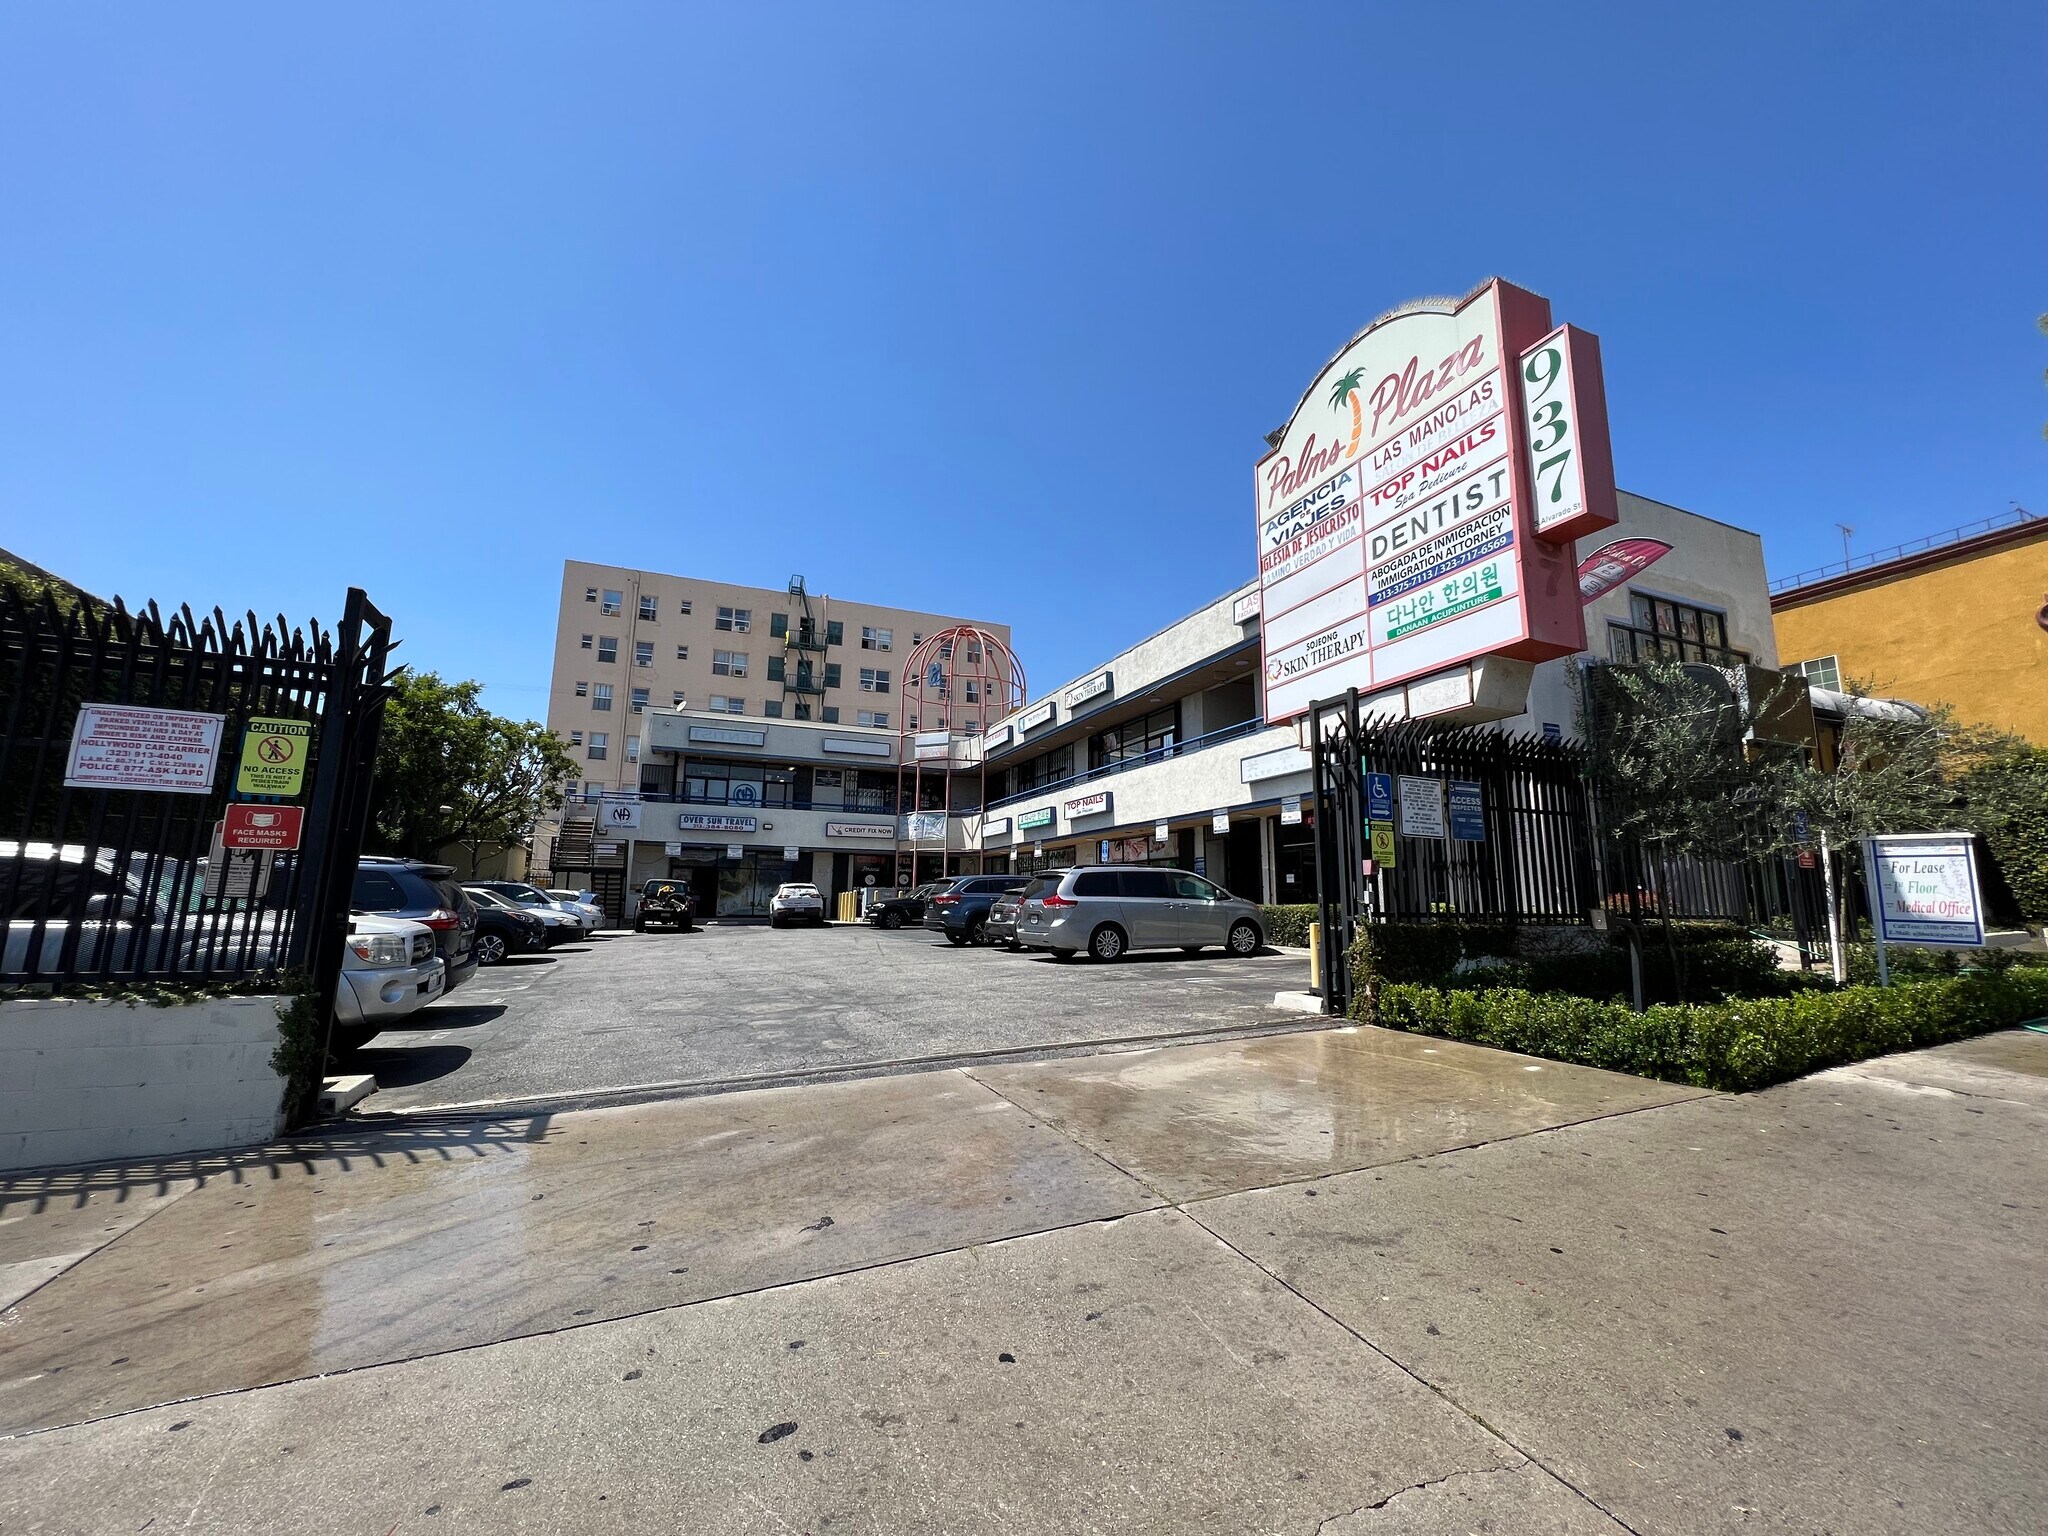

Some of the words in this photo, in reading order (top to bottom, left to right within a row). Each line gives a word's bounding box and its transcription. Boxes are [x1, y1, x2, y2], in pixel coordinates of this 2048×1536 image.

[1267, 433, 1347, 509] Palms
[1369, 334, 1484, 438] Plaza
[1374, 441, 1402, 471] LAS
[1409, 381, 1493, 448] MANOLAS
[1525, 348, 1571, 503] 937
[1375, 451, 1414, 483] SALON
[1438, 399, 1499, 444] BELLEZA
[1370, 472, 1415, 507] TOP
[1421, 421, 1496, 479] NAILS
[1394, 492, 1416, 510] Spa
[1418, 462, 1468, 495] Pedicure
[1265, 473, 1352, 536] AGENCIA
[1300, 509, 1311, 519] DE
[1371, 468, 1506, 561] DENTIST
[1272, 495, 1345, 546] VIAJES
[1261, 544, 1291, 575] IGLESIA
[1292, 537, 1303, 556] DE
[1304, 503, 1360, 549] JESUCRISTO
[1293, 542, 1327, 569] VERDAD
[1328, 537, 1335, 550] Y
[1337, 525, 1357, 545] VIDA
[1371, 553, 1418, 581] ABOGADA
[1419, 543, 1433, 560] DE
[1434, 505, 1511, 554] INMIGRACION
[1377, 548, 1445, 590] IMMIGRATION
[1446, 522, 1504, 561] ATTORNEY
[1376, 570, 1433, 602] 213-375-7113
[1439, 537, 1507, 577] 323-717-6569
[1387, 591, 1434, 625] 다나안
[1443, 563, 1499, 603] 한의원
[1396, 617, 1428, 636] DANAAN
[1430, 594, 1490, 623] ACUPUNTURE
[1306, 631, 1338, 651] SOJEONG
[1284, 653, 1310, 677] SKIN
[1311, 630, 1366, 667] THERAPY
[91, 709, 151, 720] UNAUTHORIZED
[165, 714, 213, 725] IMPROPERLY
[100, 716, 129, 725] PARKED
[131, 719, 169, 728] VEHICLES
[171, 721, 189, 729] WILL
[93, 730, 129, 738] OWNER'S
[149, 733, 166, 741] AND
[168, 735, 203, 743] EXPENSE
[94, 723, 140, 732] IMPOUNDED
[250, 722, 308, 736] CAUTION
[81, 739, 142, 749] HOLLYWOOD
[144, 743, 165, 751] CAR
[168, 745, 210, 755] CARRIER
[134, 751, 183, 761] 913-4040
[79, 762, 120, 771] POLICE
[123, 765, 203, 777] 877-ASK-LAPD
[243, 765, 259, 773] NO
[261, 767, 301, 776] ACCESS
[1066, 801, 1082, 810] TOP
[1082, 794, 1104, 806] NAILS
[1451, 796, 1481, 806] ACCESS
[683, 816, 704, 824] OVER
[706, 817, 722, 825] SUN
[725, 818, 753, 827] TRAVEL
[237, 836, 282, 845] REQUIRED
[1891, 861, 1911, 874] For
[1913, 861, 1945, 874] Lease
[1908, 880, 1938, 894] Floor
[1896, 900, 1935, 915] Medical
[1938, 901, 1971, 917] Office
